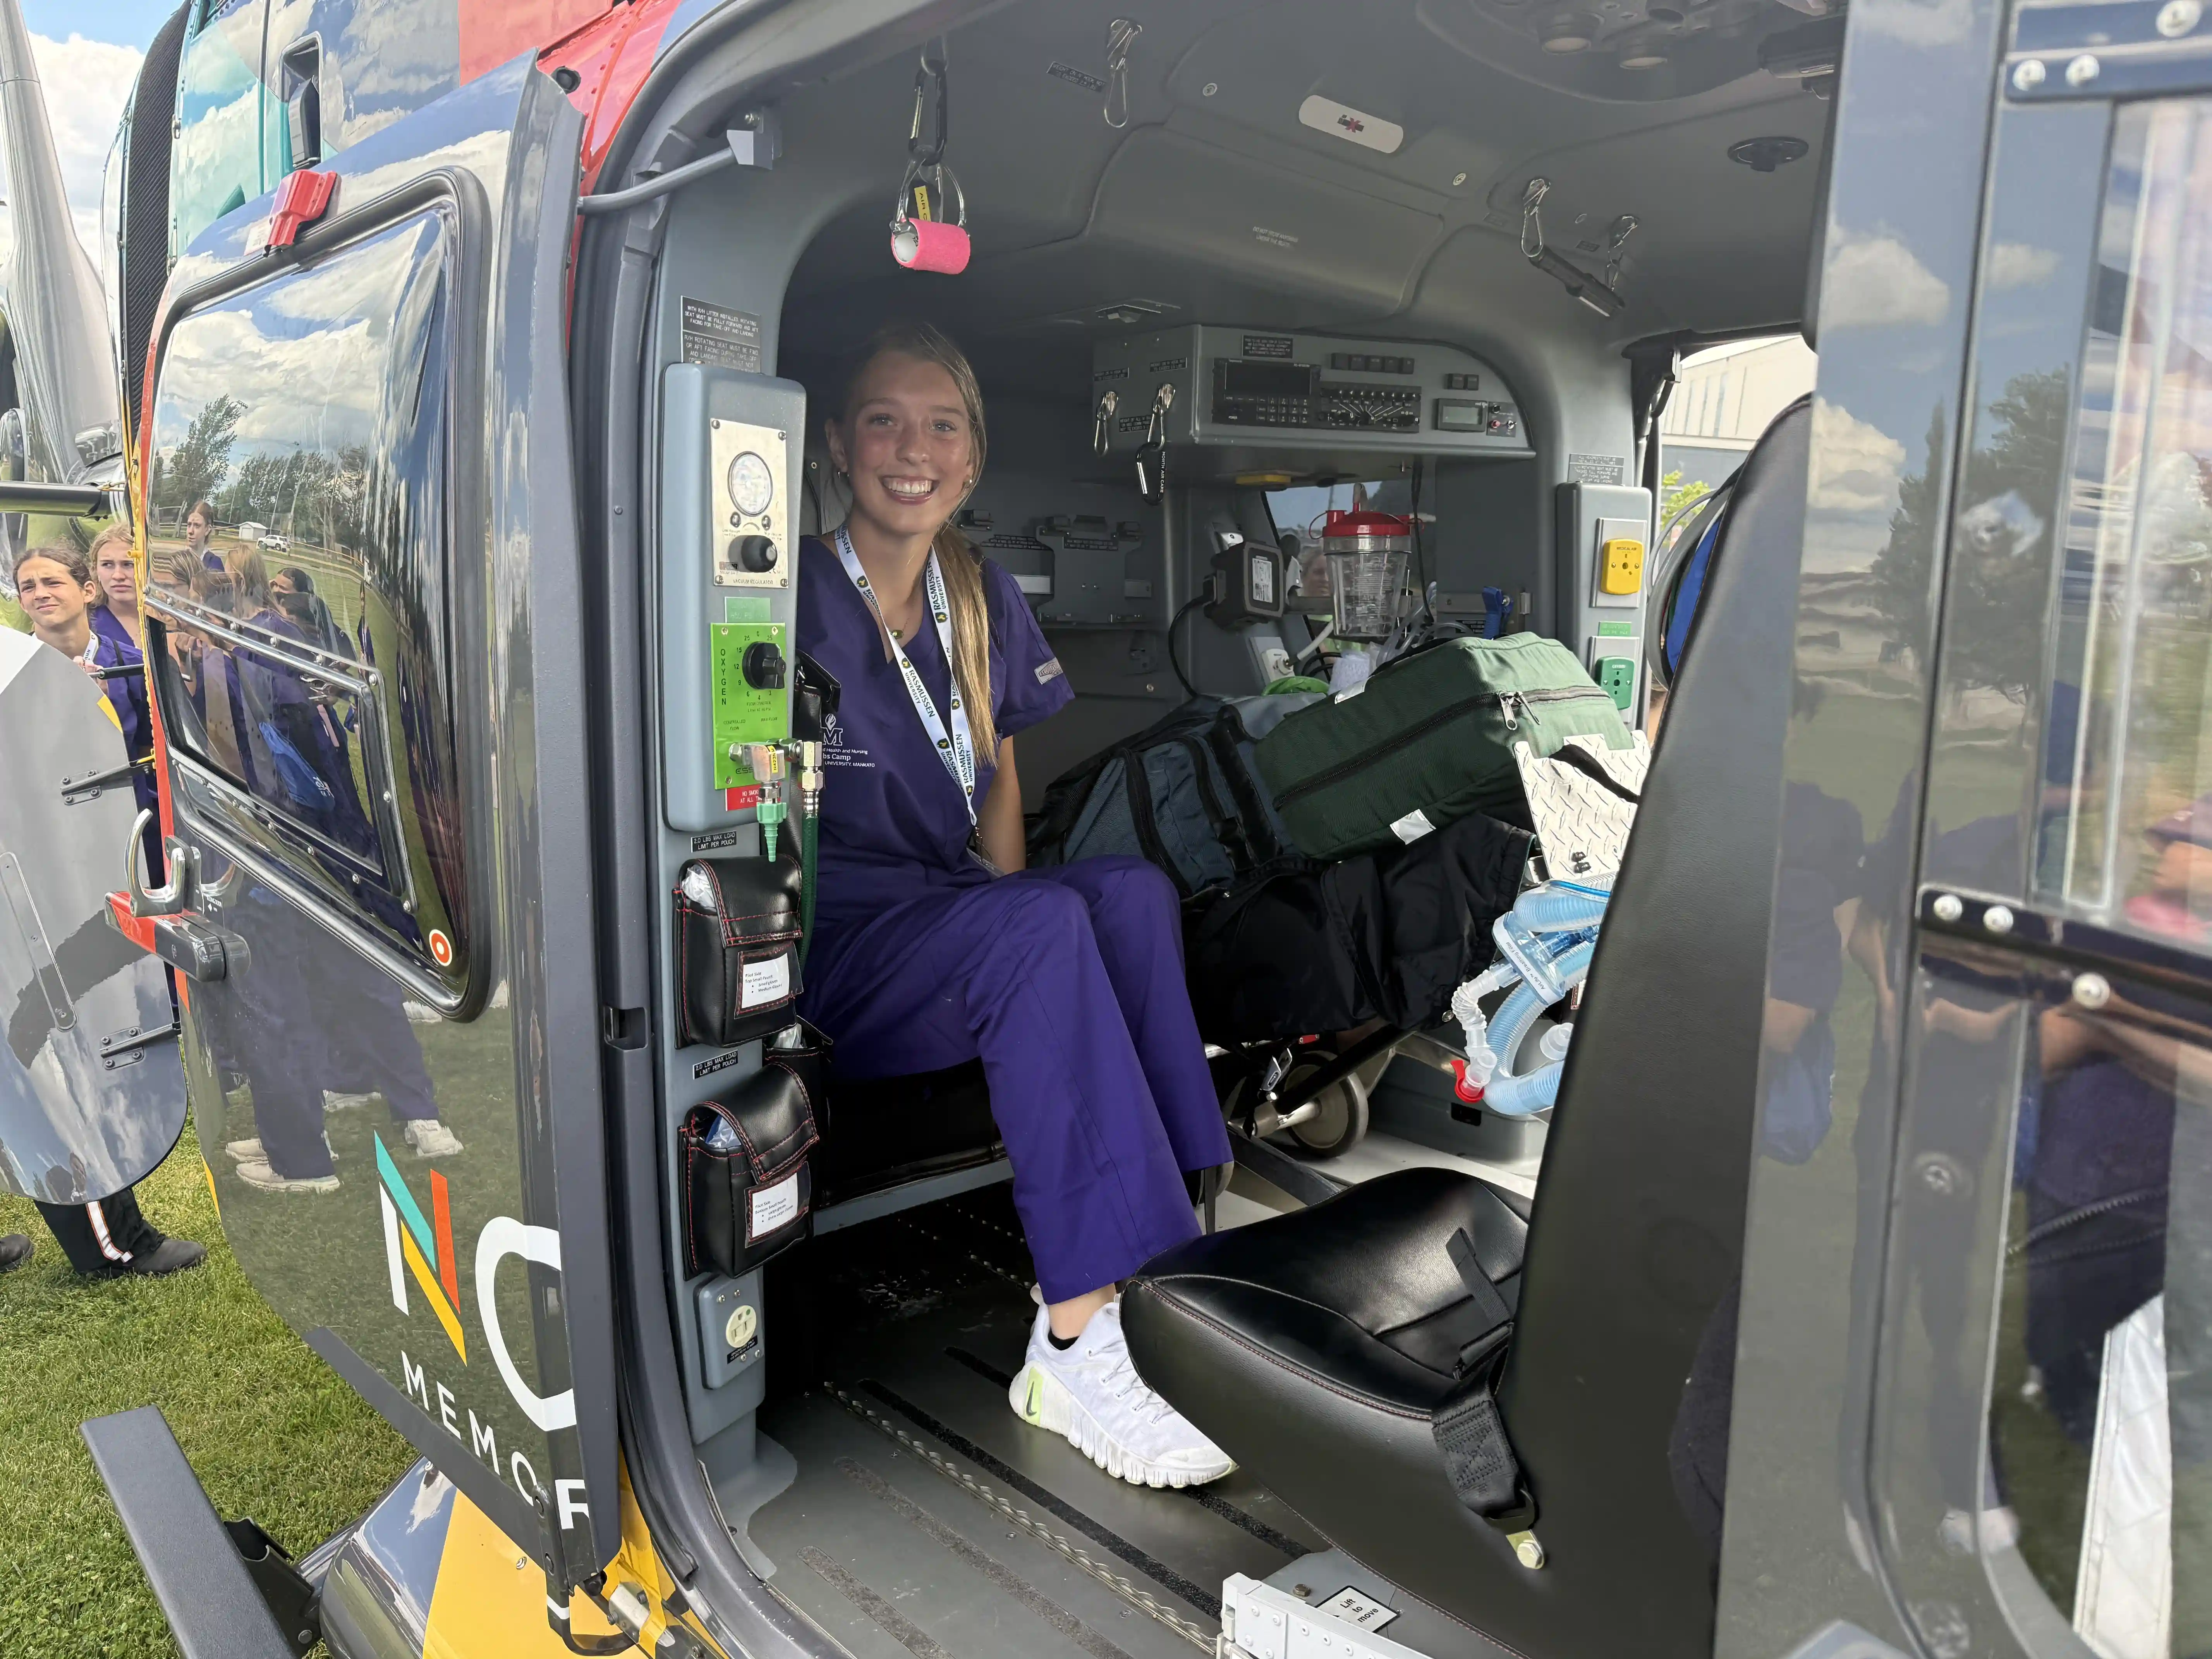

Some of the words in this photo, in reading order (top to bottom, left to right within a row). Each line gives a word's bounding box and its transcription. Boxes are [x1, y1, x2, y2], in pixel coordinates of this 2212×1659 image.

[740, 318, 757, 326] ROTATING
[695, 337, 715, 347] ROTATING
[928, 561, 941, 610] RASMUSSEN
[935, 576, 946, 609] UNIVERSITY
[905, 672, 921, 703] UNIVERSITY
[909, 670, 935, 717] RASMUSSEN
[821, 728, 843, 746] M
[956, 734, 969, 783] RASMUSSEN
[1515, 952, 1531, 972] Breathing
[726, 1052, 737, 1060] LOAD
[700, 1067, 711, 1075] LIMIT
[723, 1058, 736, 1067] POUCH
[1340, 1599, 1356, 1608] Lift
[1357, 1608, 1379, 1622] move
